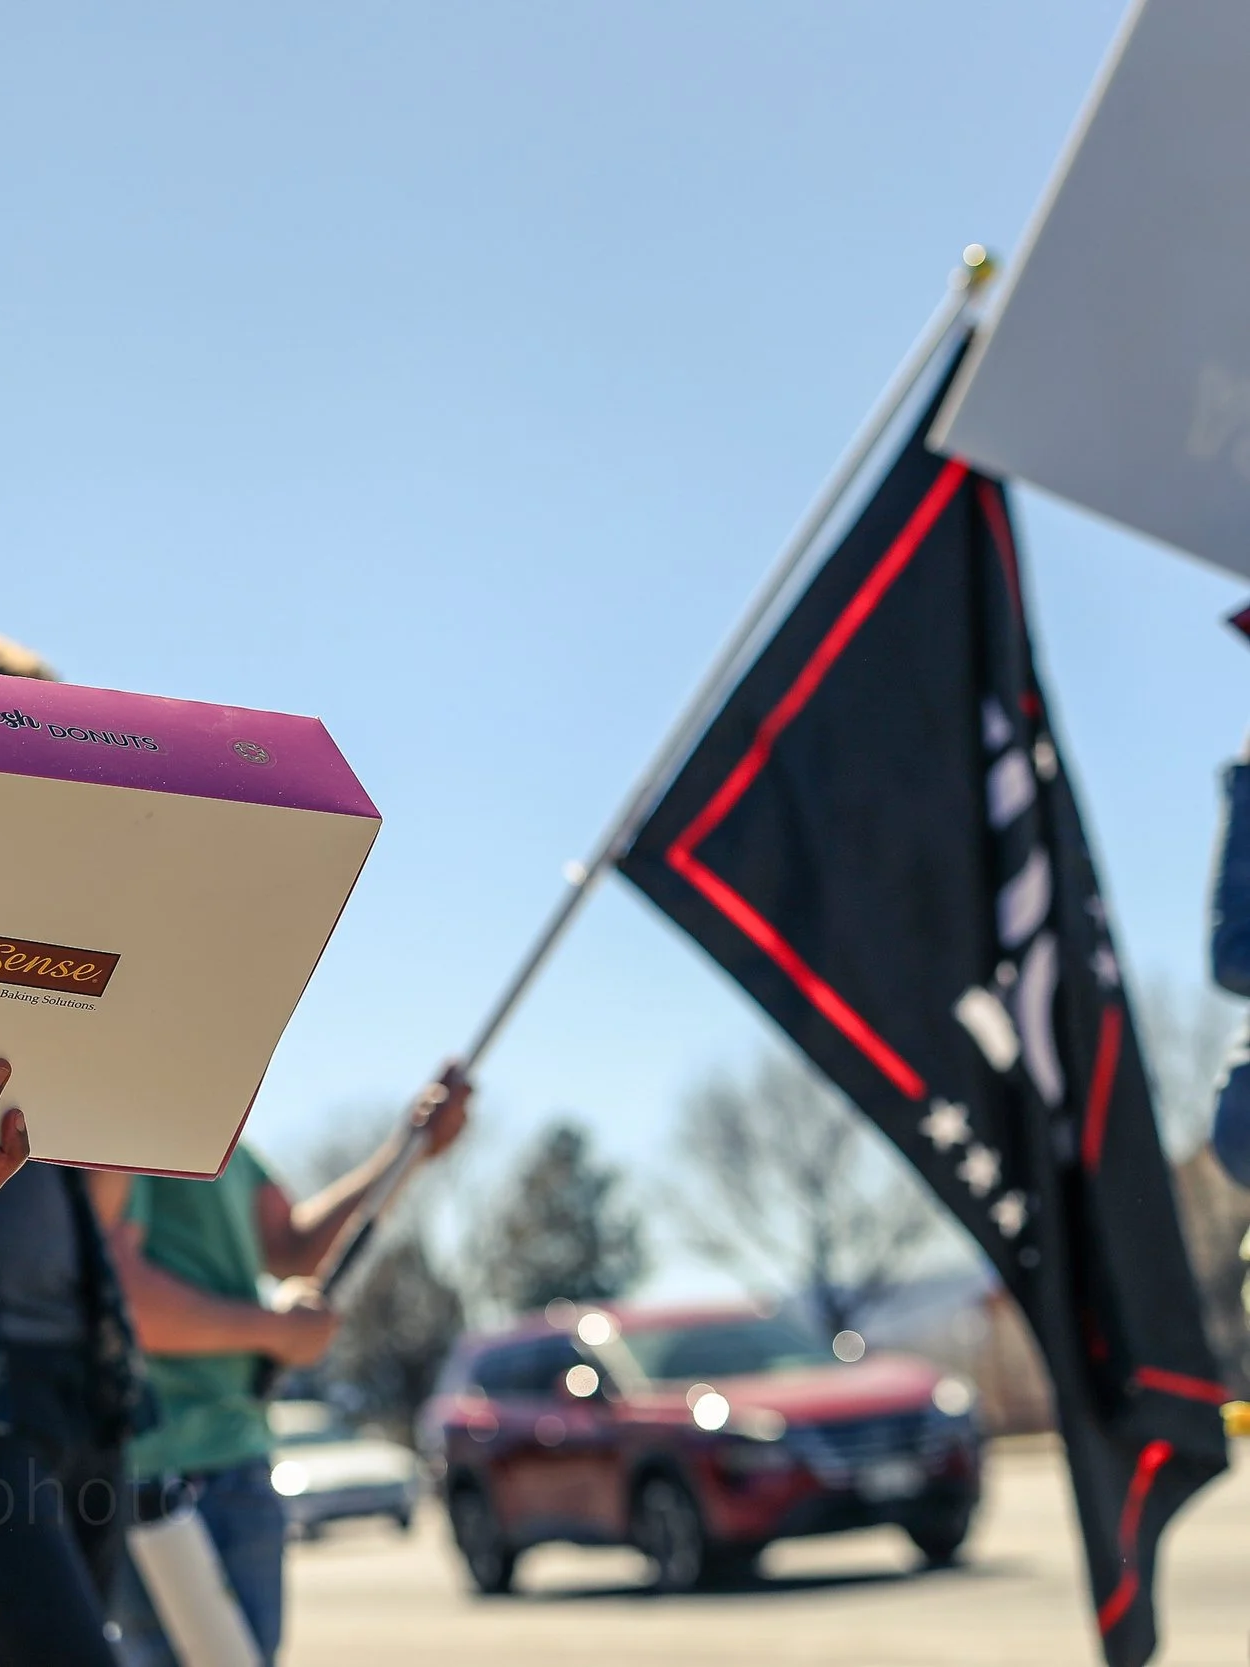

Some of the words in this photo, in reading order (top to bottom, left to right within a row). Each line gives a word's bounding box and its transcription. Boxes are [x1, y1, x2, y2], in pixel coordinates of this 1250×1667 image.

[47, 723, 160, 752] DONUTS
[0, 988, 40, 1006] Baking
[41, 994, 98, 1011] Solutions.
